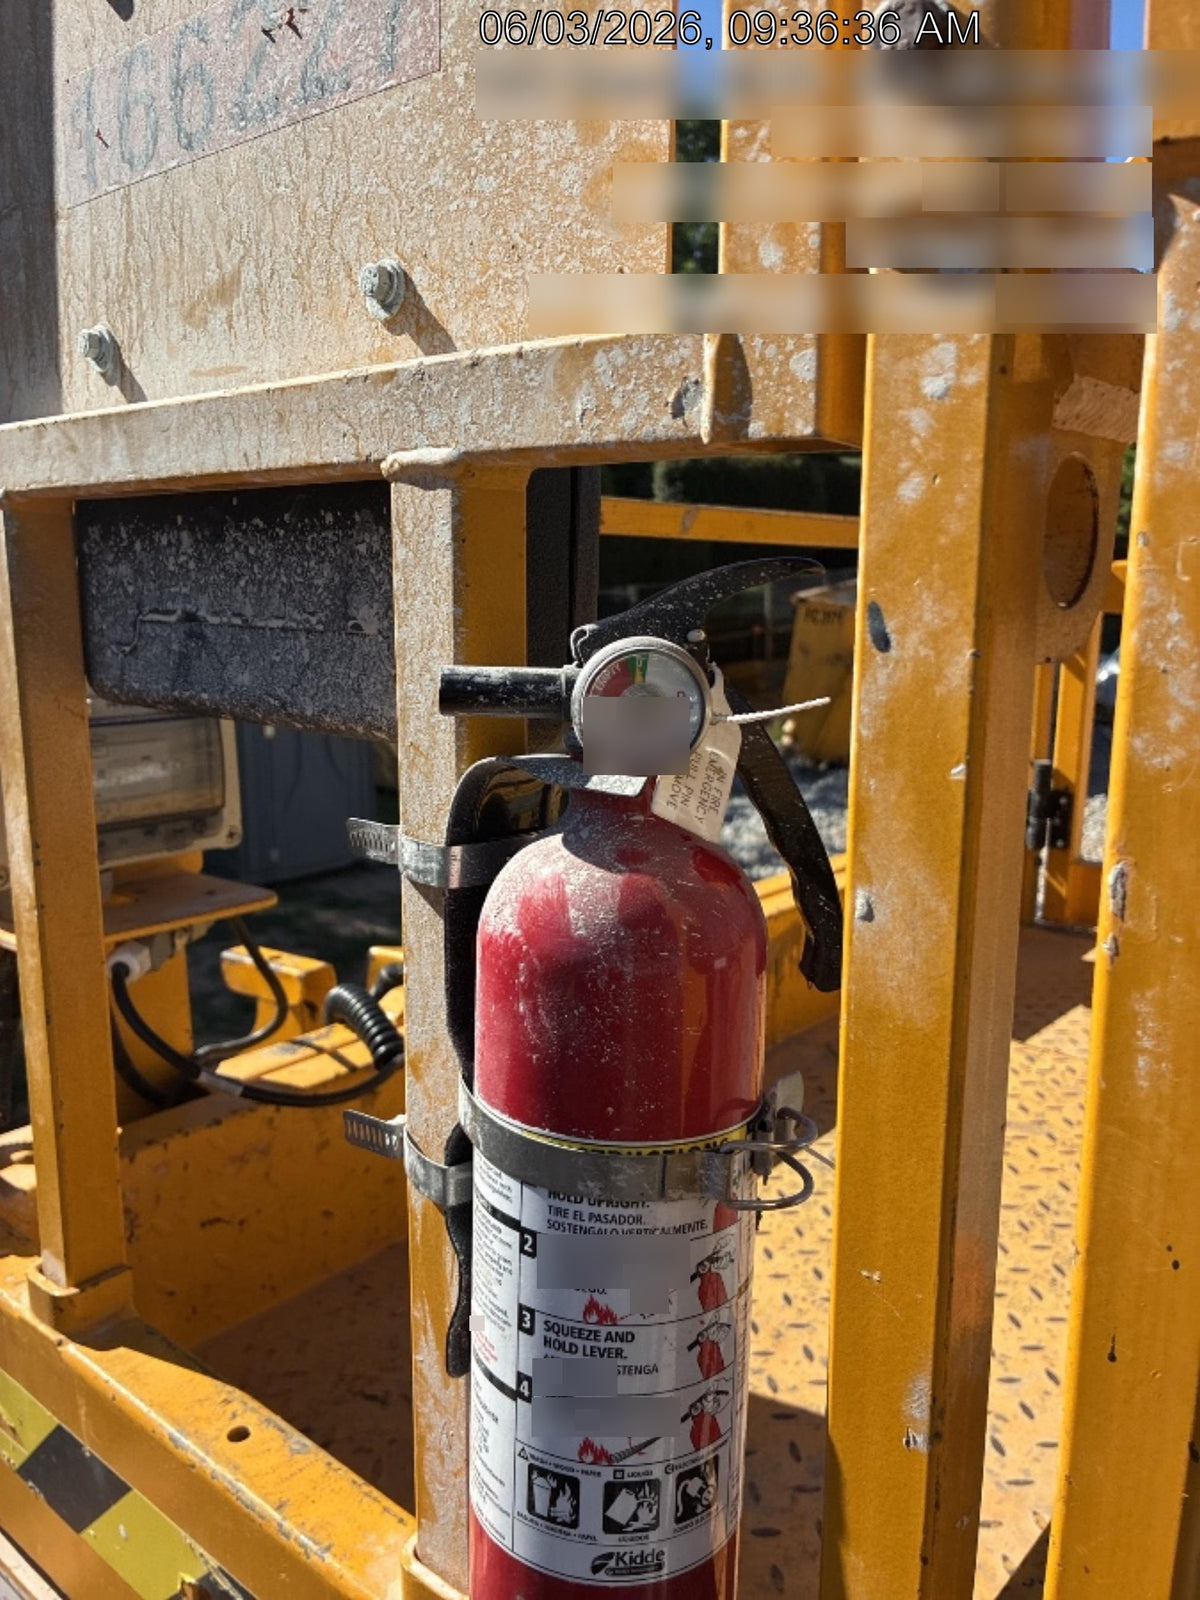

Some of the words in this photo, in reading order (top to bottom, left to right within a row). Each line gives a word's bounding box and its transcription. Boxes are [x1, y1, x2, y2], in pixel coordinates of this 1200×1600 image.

[680, 785, 694, 808] PIN
[710, 787, 724, 815] FIRE
[547, 1205, 570, 1219] TIRE
[573, 1211, 587, 1223] EL
[588, 1212, 647, 1226] PASADOR.
[523, 1234, 534, 1253] 2
[521, 1310, 532, 1329] 3
[543, 1320, 601, 1340] SQUEEZE
[604, 1331, 635, 1343] AND
[543, 1337, 579, 1354] HOLD
[582, 1346, 628, 1359] LEVER.
[616, 1363, 659, 1376] STENGA
[520, 1380, 530, 1397] 4
[615, 1549, 666, 1567] Kidde
